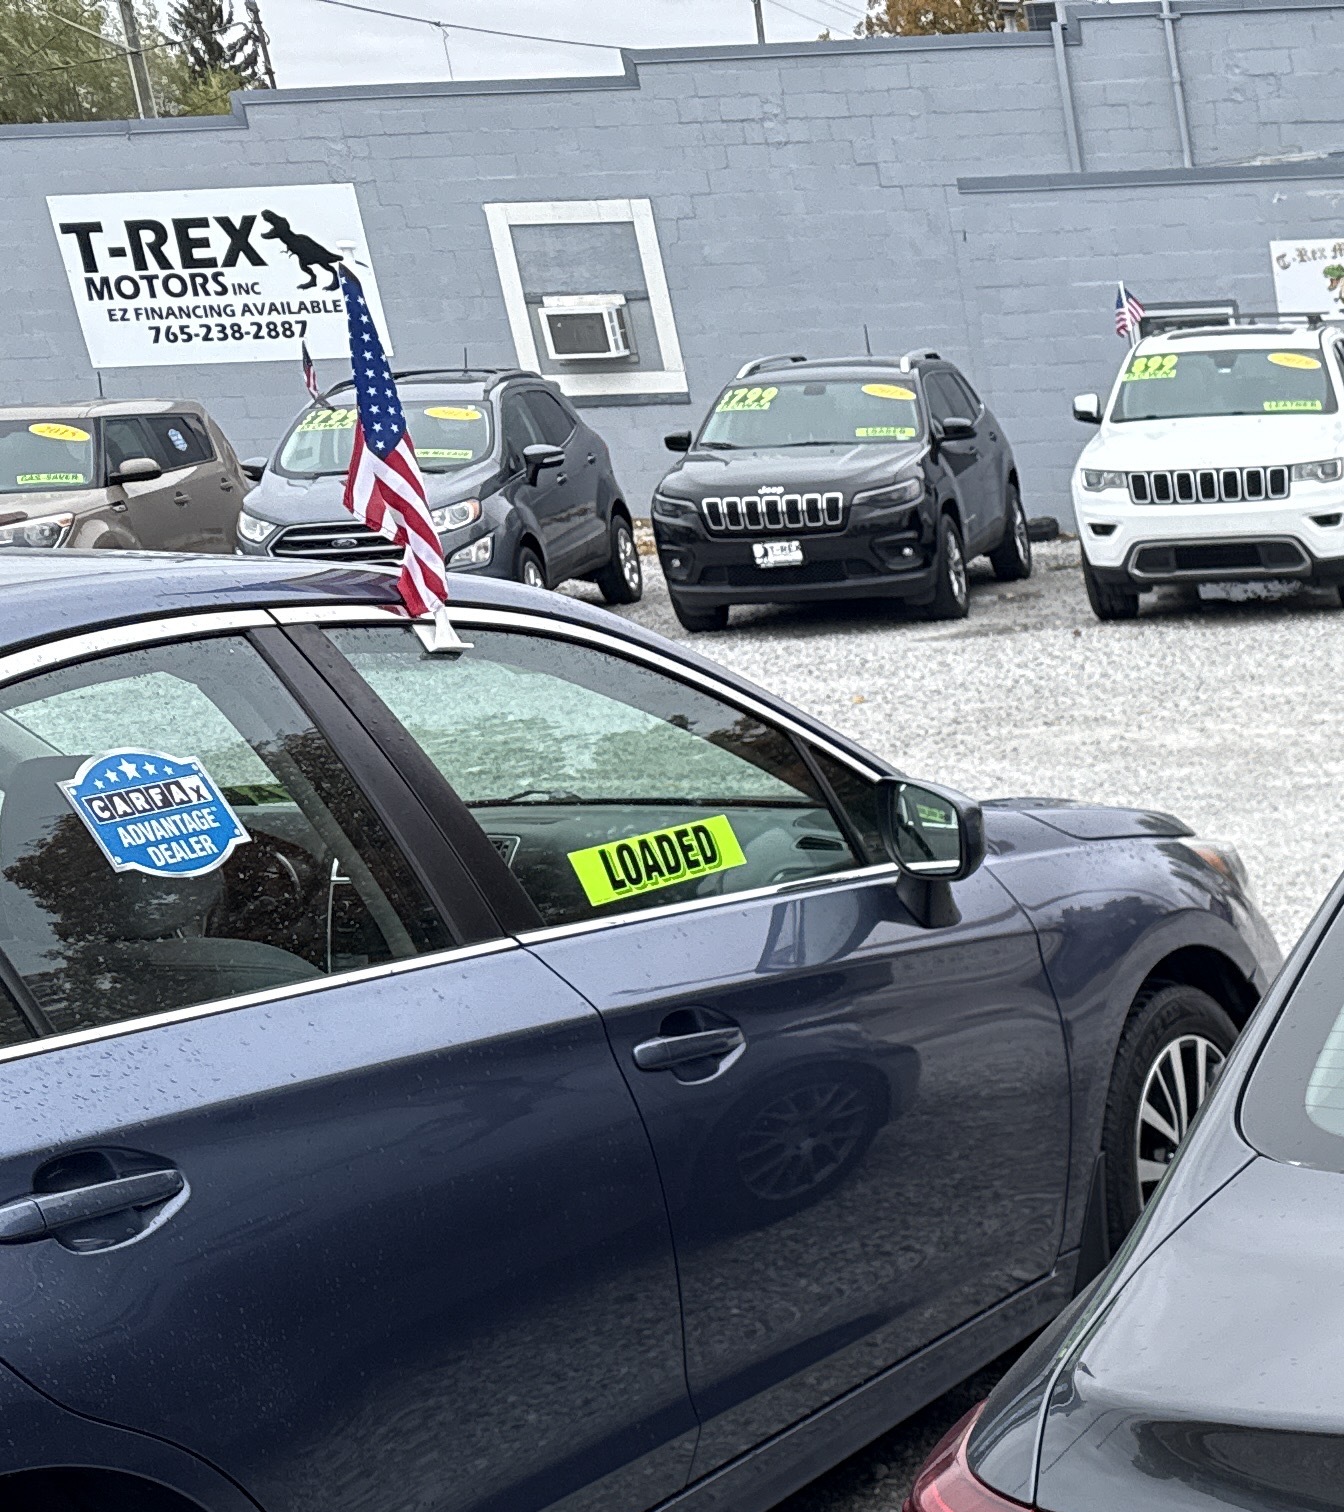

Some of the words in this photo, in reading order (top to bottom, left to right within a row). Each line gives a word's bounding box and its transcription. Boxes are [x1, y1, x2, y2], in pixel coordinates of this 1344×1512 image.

[59, 214, 269, 273] T-REX
[84, 271, 229, 301] MOTORS
[232, 282, 261, 296] INC
[107, 308, 130, 322] EZ
[134, 304, 236, 321] FINANCING
[241, 300, 344, 317] AVAILABLE
[148, 320, 308, 344] 765-238-2887
[91, 782, 208, 819] CARFAX
[116, 808, 221, 848] ADVANTAGE
[147, 835, 219, 867] DEALER
[598, 824, 722, 895] LOADED
